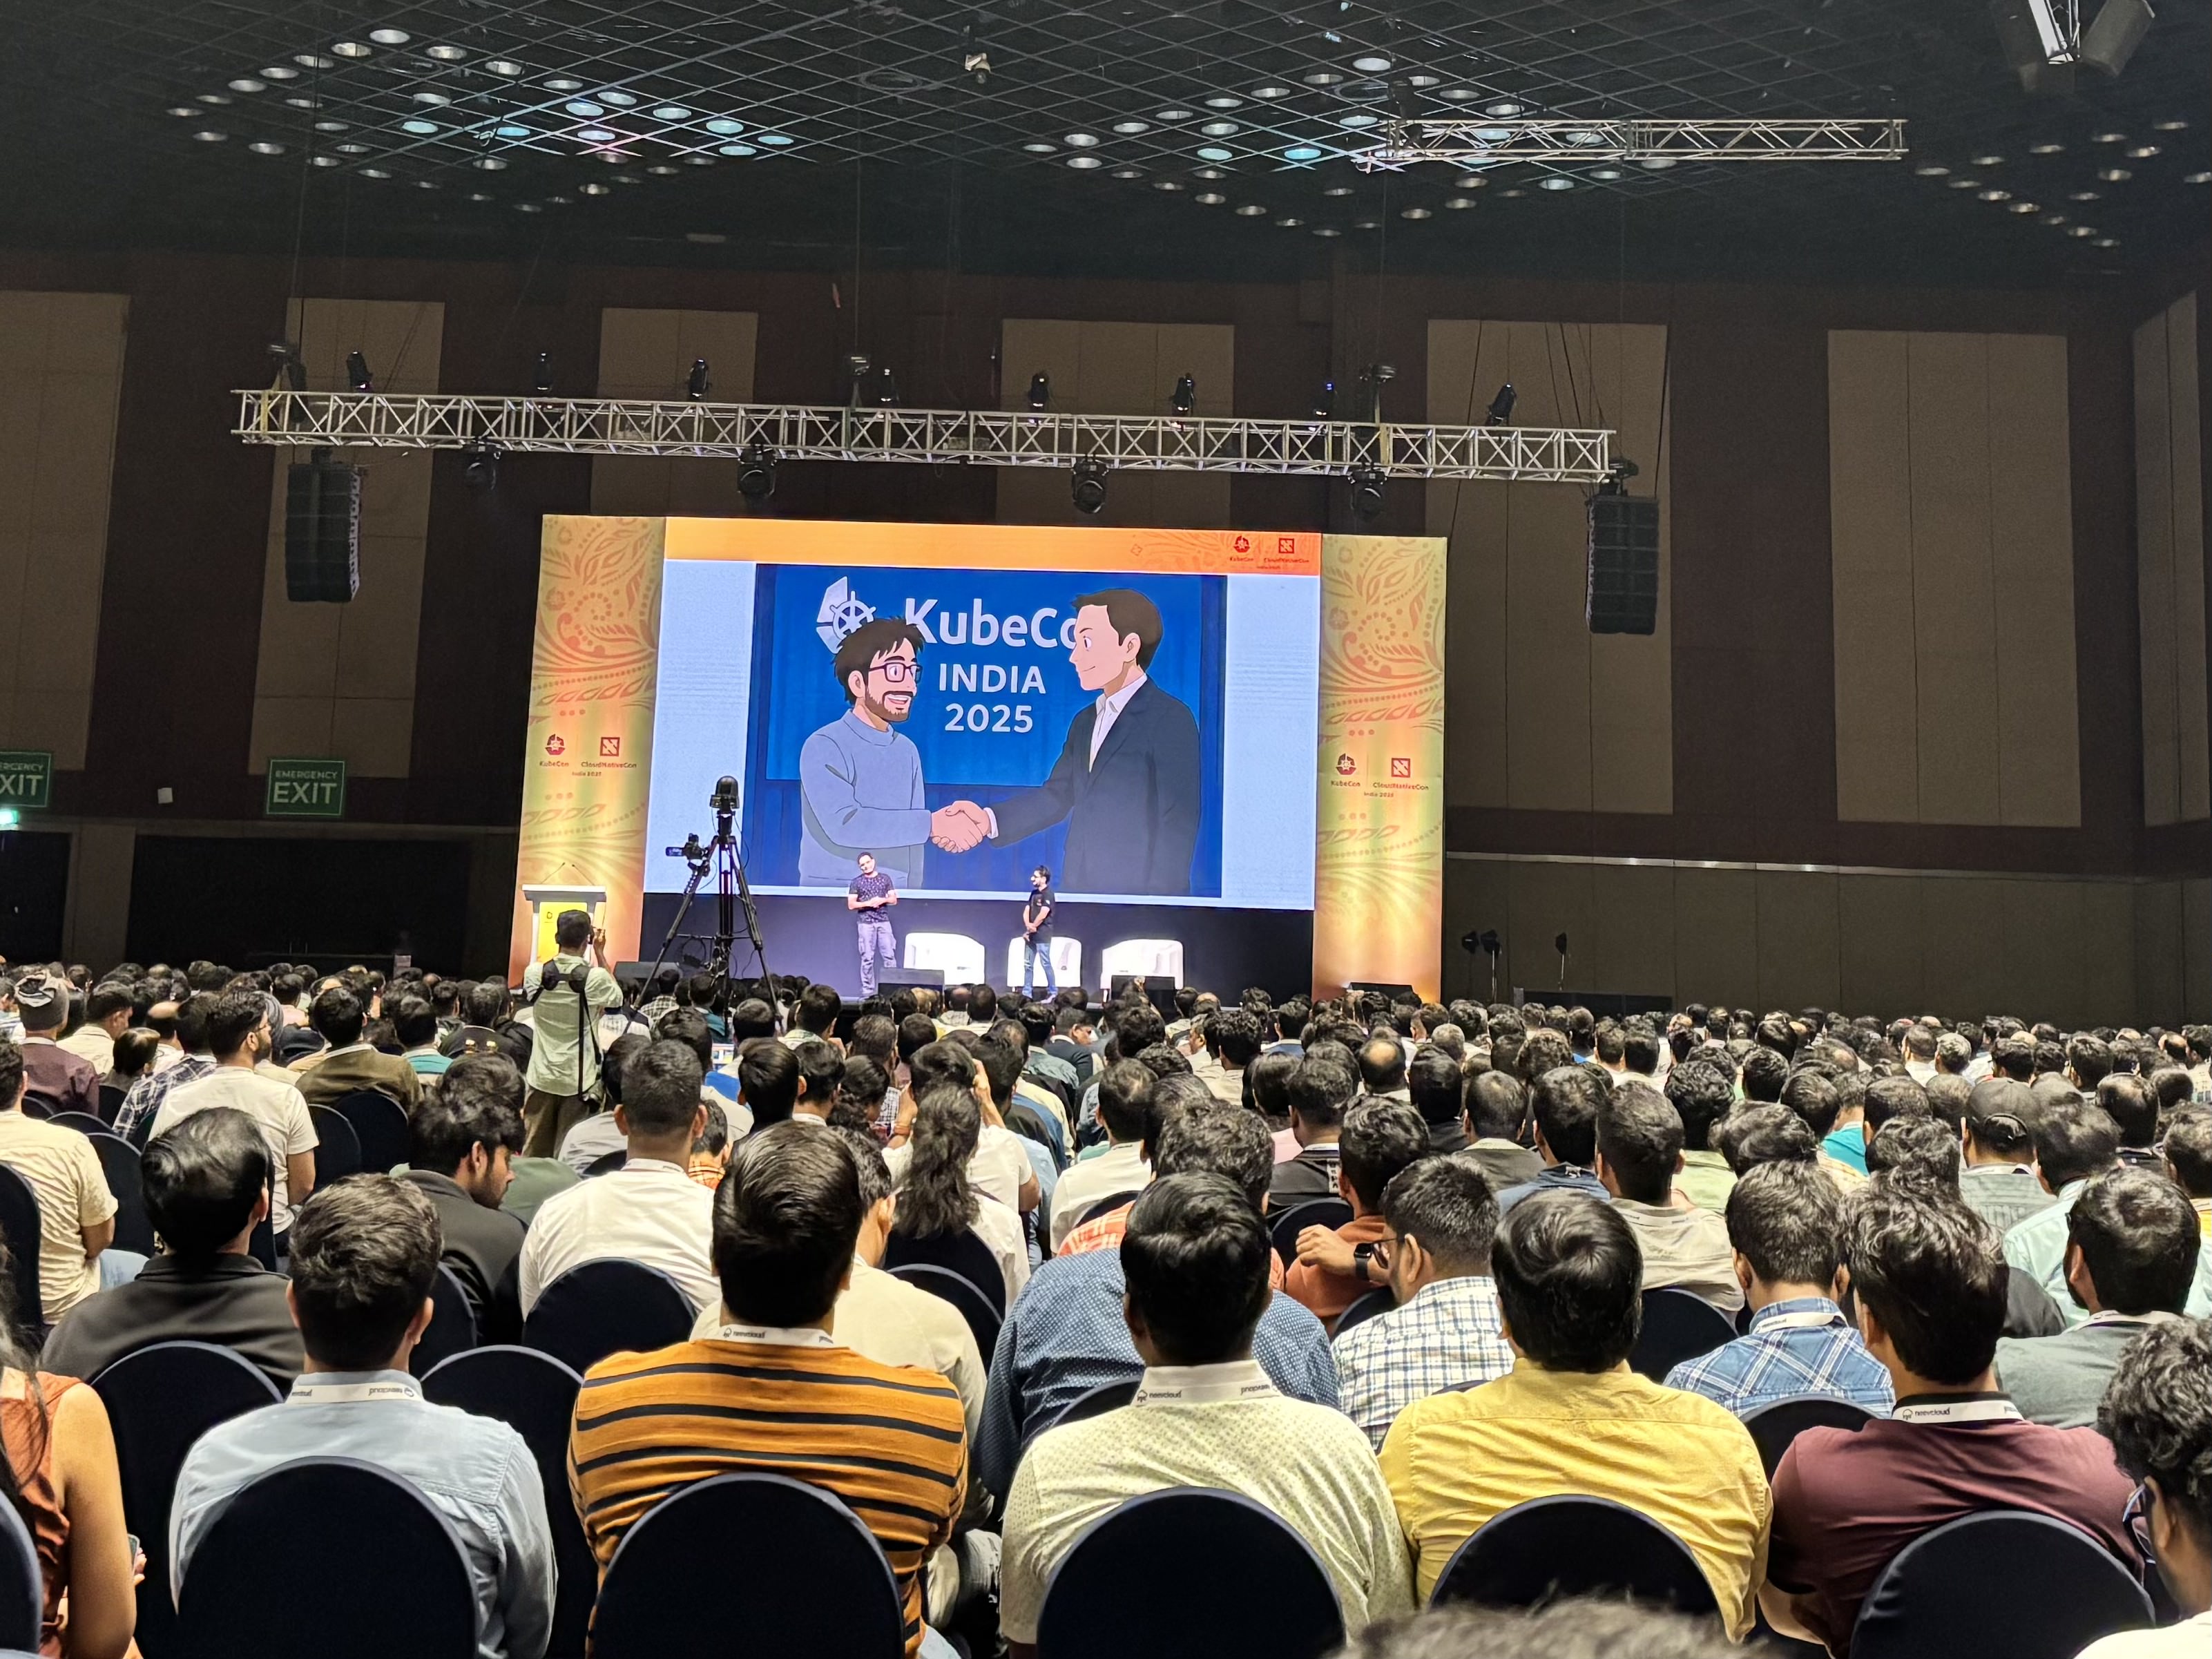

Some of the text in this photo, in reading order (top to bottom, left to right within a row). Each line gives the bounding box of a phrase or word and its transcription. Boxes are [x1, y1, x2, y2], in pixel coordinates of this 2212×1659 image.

[939, 663, 1046, 694] INDIA
[945, 702, 1033, 733] 2025
[0, 774, 44, 796] XIT
[276, 770, 337, 779] EMERGENCY
[273, 782, 337, 804] EXIT
[1373, 781, 1430, 791] CloudNativeCon
